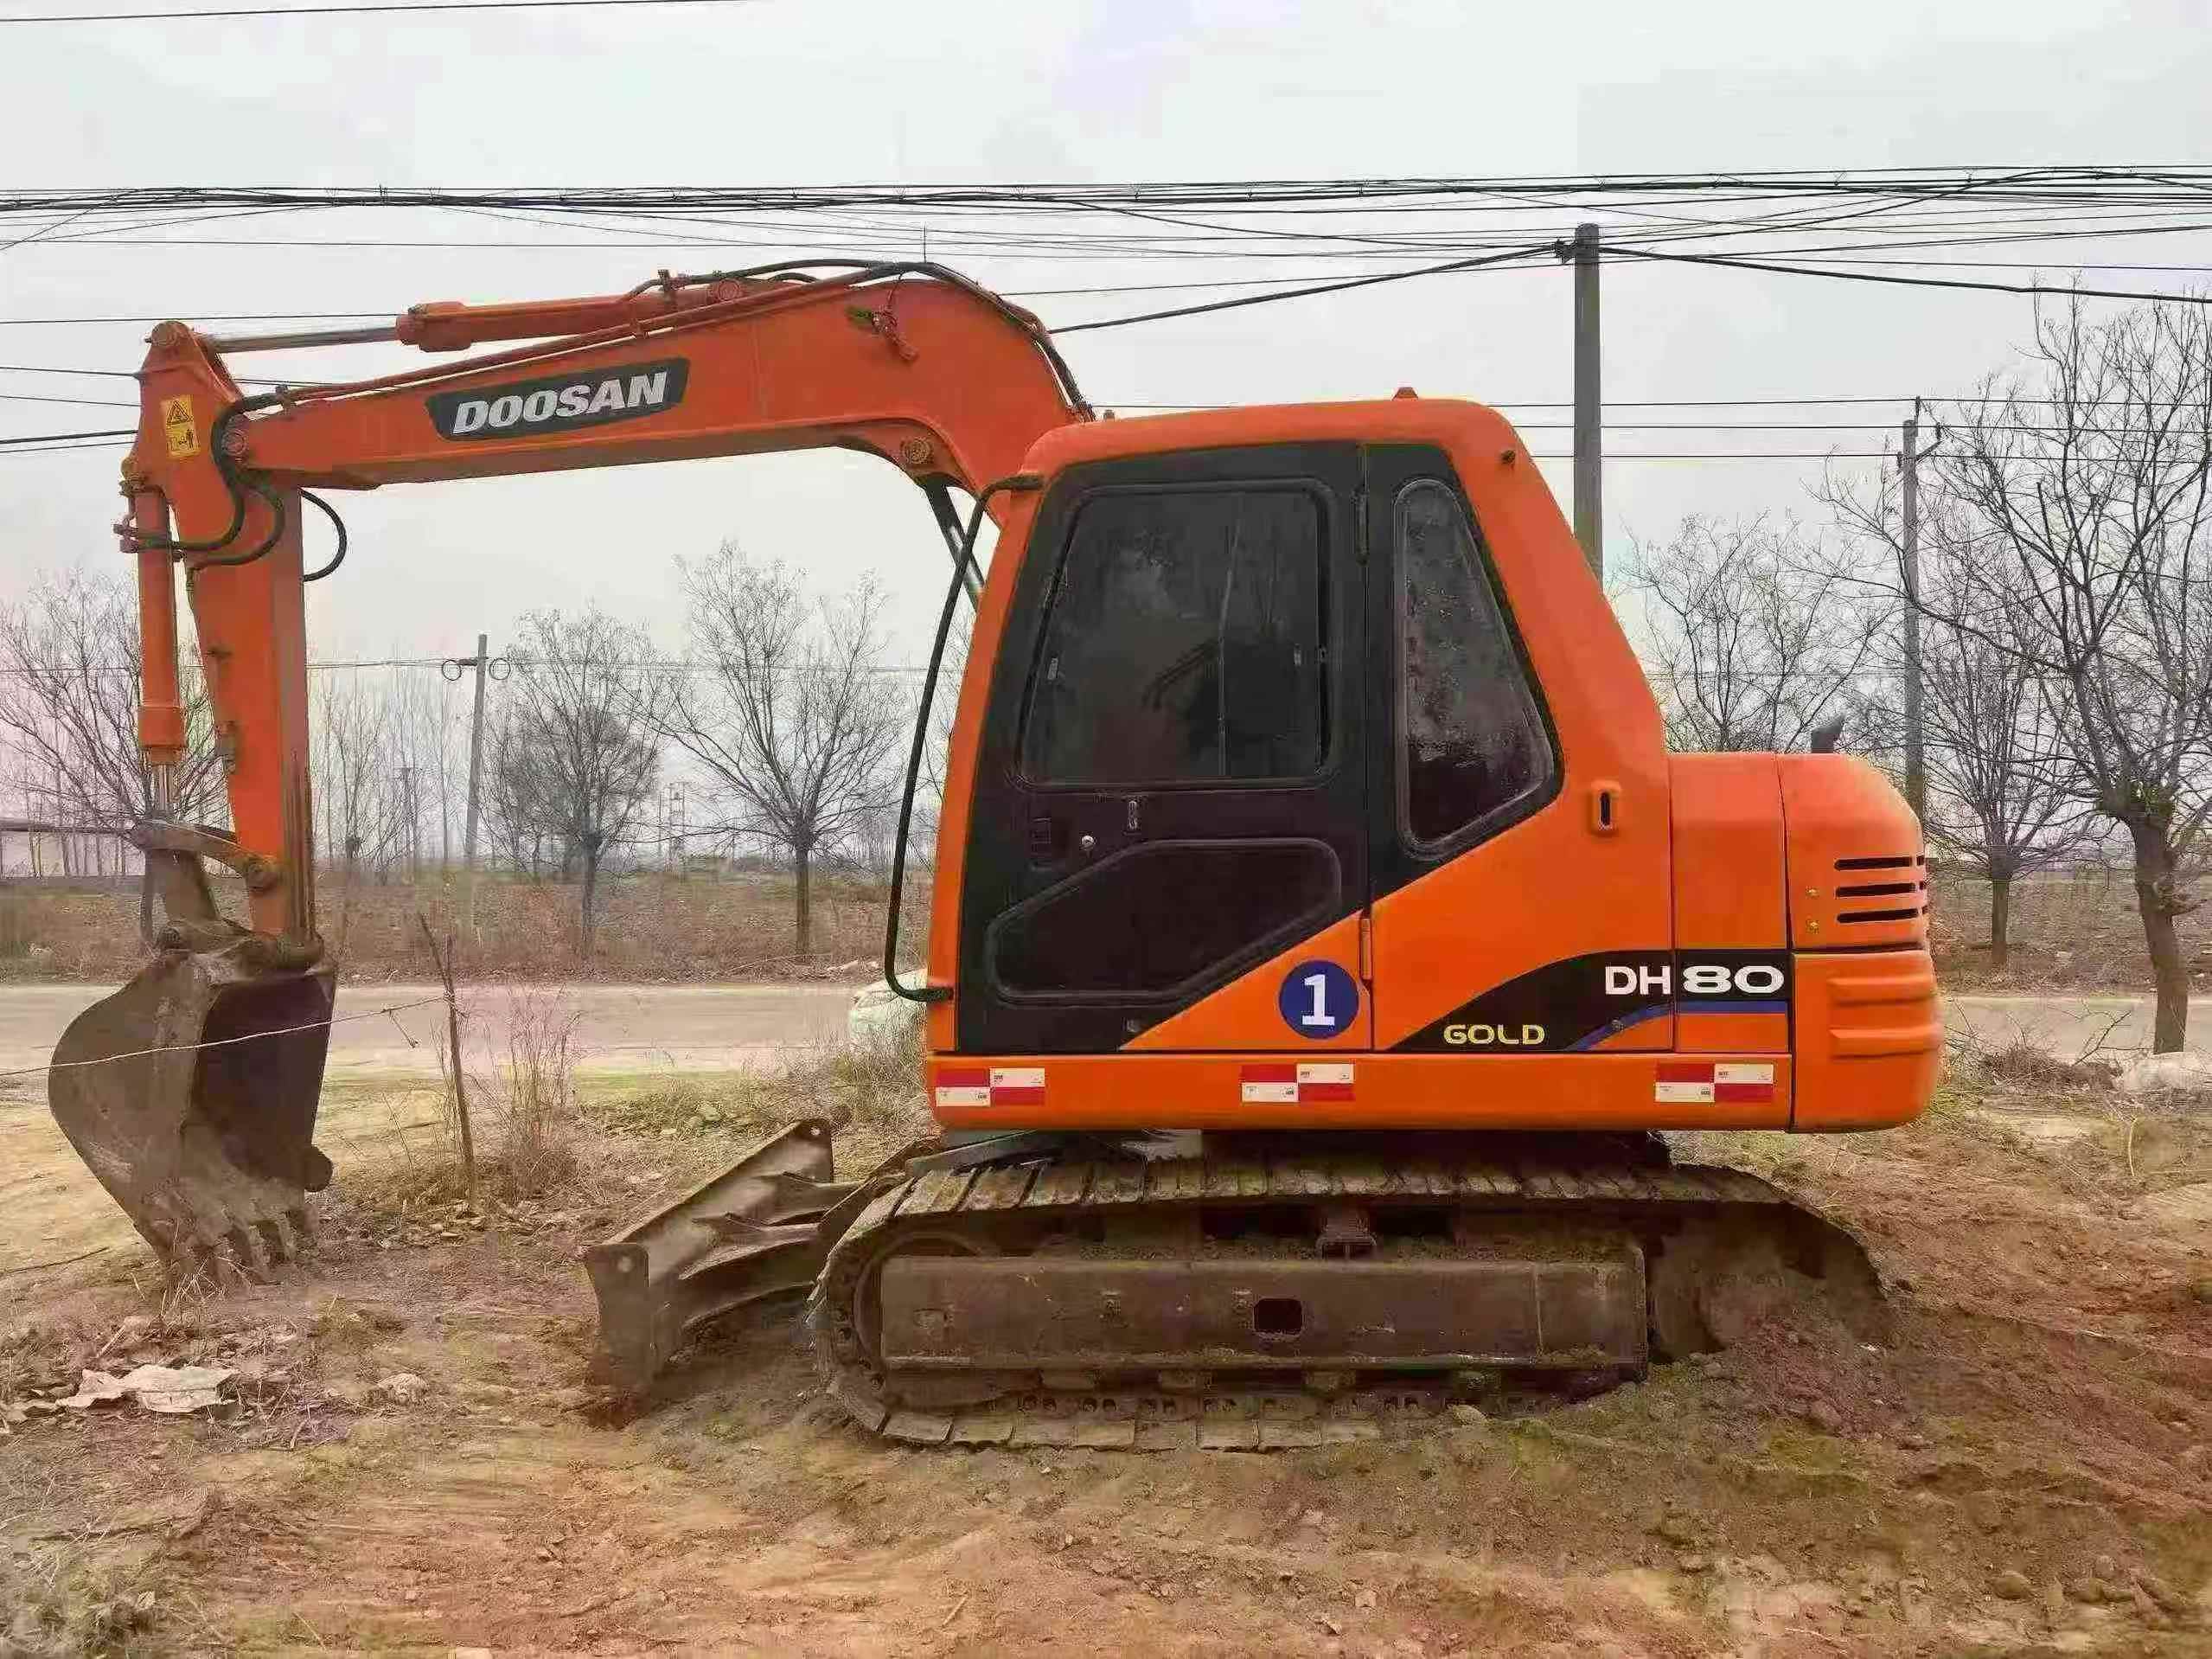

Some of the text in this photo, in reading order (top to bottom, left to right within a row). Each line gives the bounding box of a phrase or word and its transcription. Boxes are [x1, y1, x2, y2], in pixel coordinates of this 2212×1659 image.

[452, 372, 668, 435] DOOSAN
[1301, 974, 1335, 1025] 1
[1605, 965, 1785, 995] DH 80
[1443, 1024, 1546, 1045] GOLD
